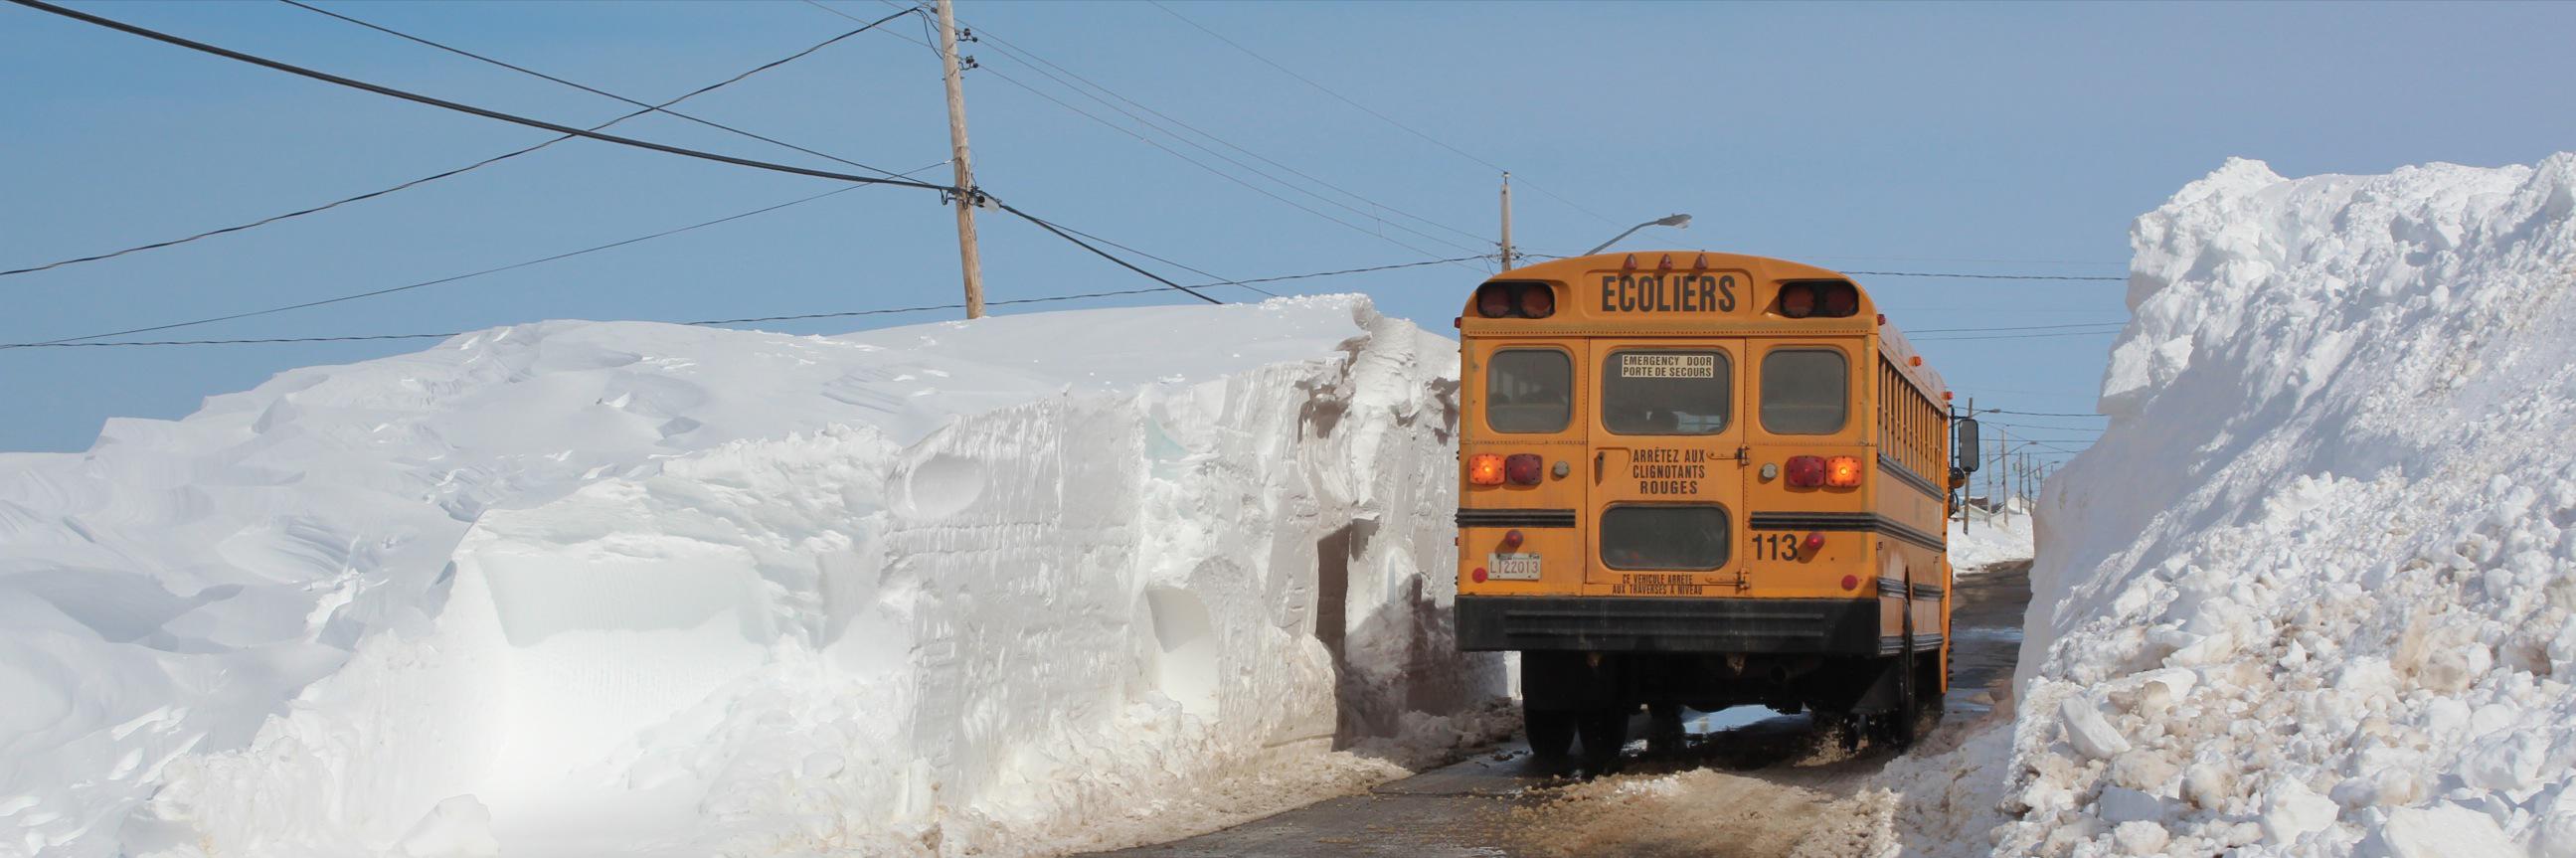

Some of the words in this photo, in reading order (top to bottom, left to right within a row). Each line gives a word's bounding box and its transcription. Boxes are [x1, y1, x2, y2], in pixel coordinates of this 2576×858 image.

[1602, 275, 1735, 312] ECOLIERS
[1624, 356, 1680, 366] EMERGENCY
[1686, 356, 1712, 366] DOOR
[1623, 367, 1651, 376] PORTE
[1654, 367, 1666, 377] DE
[1669, 367, 1712, 377] SECOURS
[1632, 446, 1679, 462] ARRÊTEZ
[1684, 449, 1705, 463] AUX
[1632, 465, 1705, 478] CLIGNOTANTS
[1639, 480, 1698, 494] ROUGES
[1752, 533, 1798, 561] 113
[1623, 574, 1631, 585] CE
[1612, 584, 1626, 594] AUX
[1630, 584, 1666, 595] TRAVERSES
[1678, 584, 1703, 595] NIVEAU
